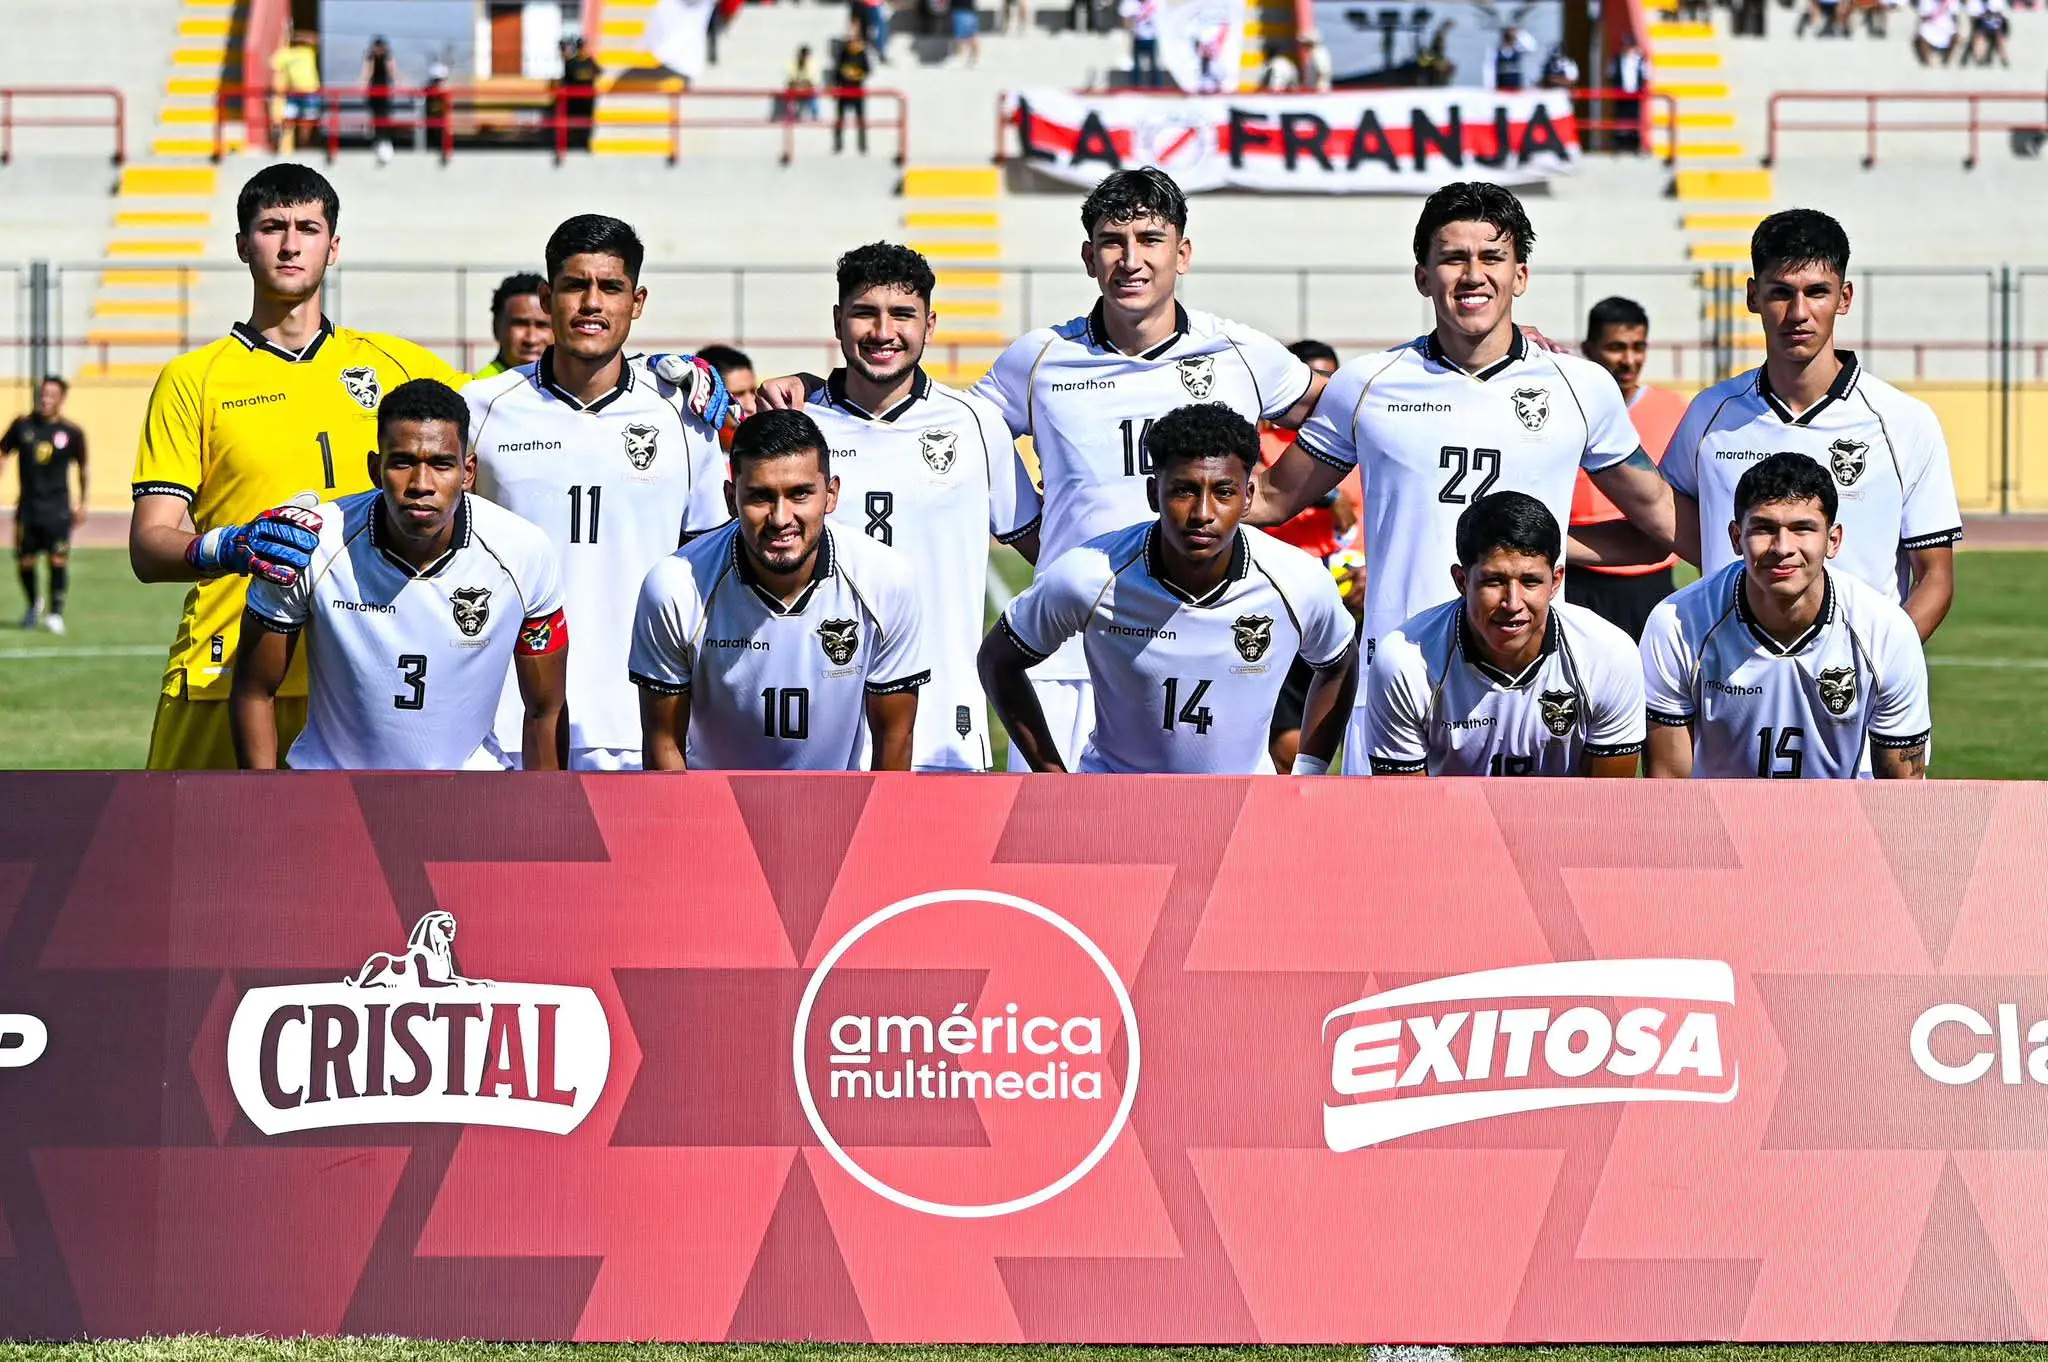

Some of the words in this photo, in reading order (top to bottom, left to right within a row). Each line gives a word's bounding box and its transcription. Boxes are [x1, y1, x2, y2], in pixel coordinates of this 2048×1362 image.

[1018, 92, 1123, 168] LA
[1228, 103, 1572, 172] FRANJA
[221, 392, 287, 410] marathon
[1052, 379, 1116, 392] marathon
[1387, 401, 1452, 413] marathon
[315, 431, 336, 489] 1
[498, 440, 562, 452] marathon
[1438, 445, 1502, 505] 22
[567, 485, 602, 544] 11
[864, 491, 894, 547] 8
[332, 599, 396, 614] marathon
[705, 637, 770, 651] marathon
[1108, 624, 1177, 641] marathon
[1246, 646, 1258, 656] FBF
[835, 649, 848, 660] FBF
[393, 654, 428, 711] 3
[1704, 680, 1763, 696] marathon
[760, 687, 810, 740] 10
[1161, 677, 1214, 735] 14
[1831, 699, 1844, 709] FBF
[1553, 721, 1566, 731] FBF
[1756, 726, 1805, 778] 15
[830, 1003, 1101, 1055] américa
[259, 1001, 577, 1110] CRISTAL
[1330, 1006, 1723, 1095] EXITOSA
[830, 1059, 1102, 1099] multimedia
